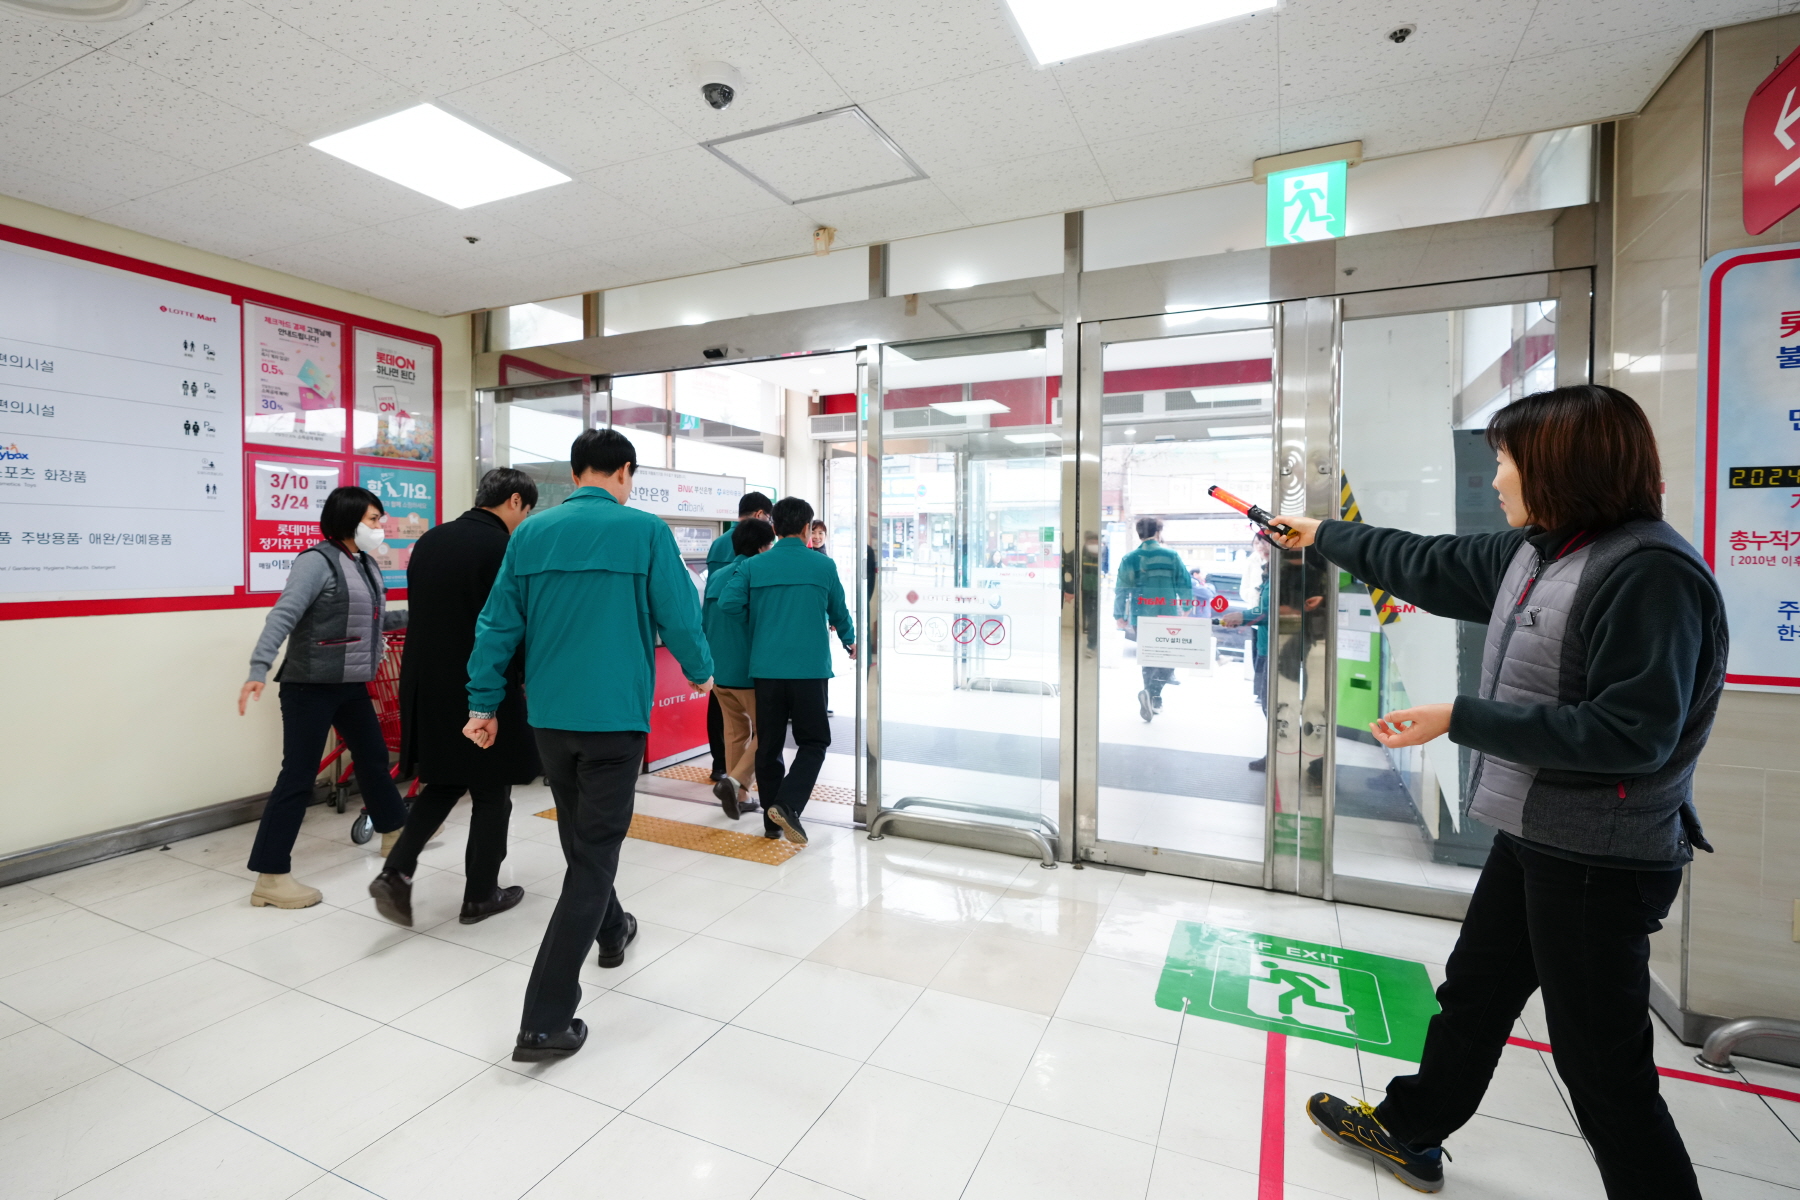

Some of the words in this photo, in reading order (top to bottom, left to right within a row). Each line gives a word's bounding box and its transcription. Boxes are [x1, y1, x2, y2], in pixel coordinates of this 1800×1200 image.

[168, 308, 195, 318] LOTTE
[197, 313, 217, 323] Mart
[376, 351, 416, 371] 롯데ON
[261, 363, 285, 376] 0.5%
[376, 365, 399, 378] 하나면
[400, 370, 416, 381] 된다
[262, 399, 284, 411] 30%
[379, 402, 396, 412] ON
[44, 468, 86, 484] 화장품
[270, 473, 309, 490] 3/10
[678, 485, 694, 494] BNK
[694, 485, 713, 495] 부산은행
[270, 494, 309, 510] 3/24
[678, 500, 705, 513] citibank
[277, 524, 321, 536] 롯데마트
[88, 532, 173, 546] 애완/원예용품
[259, 537, 304, 550] 정기휴무
[1738, 555, 1776, 567] 2010년
[659, 694, 686, 708] LOTTE
[1286, 946, 1344, 964] EXIT
